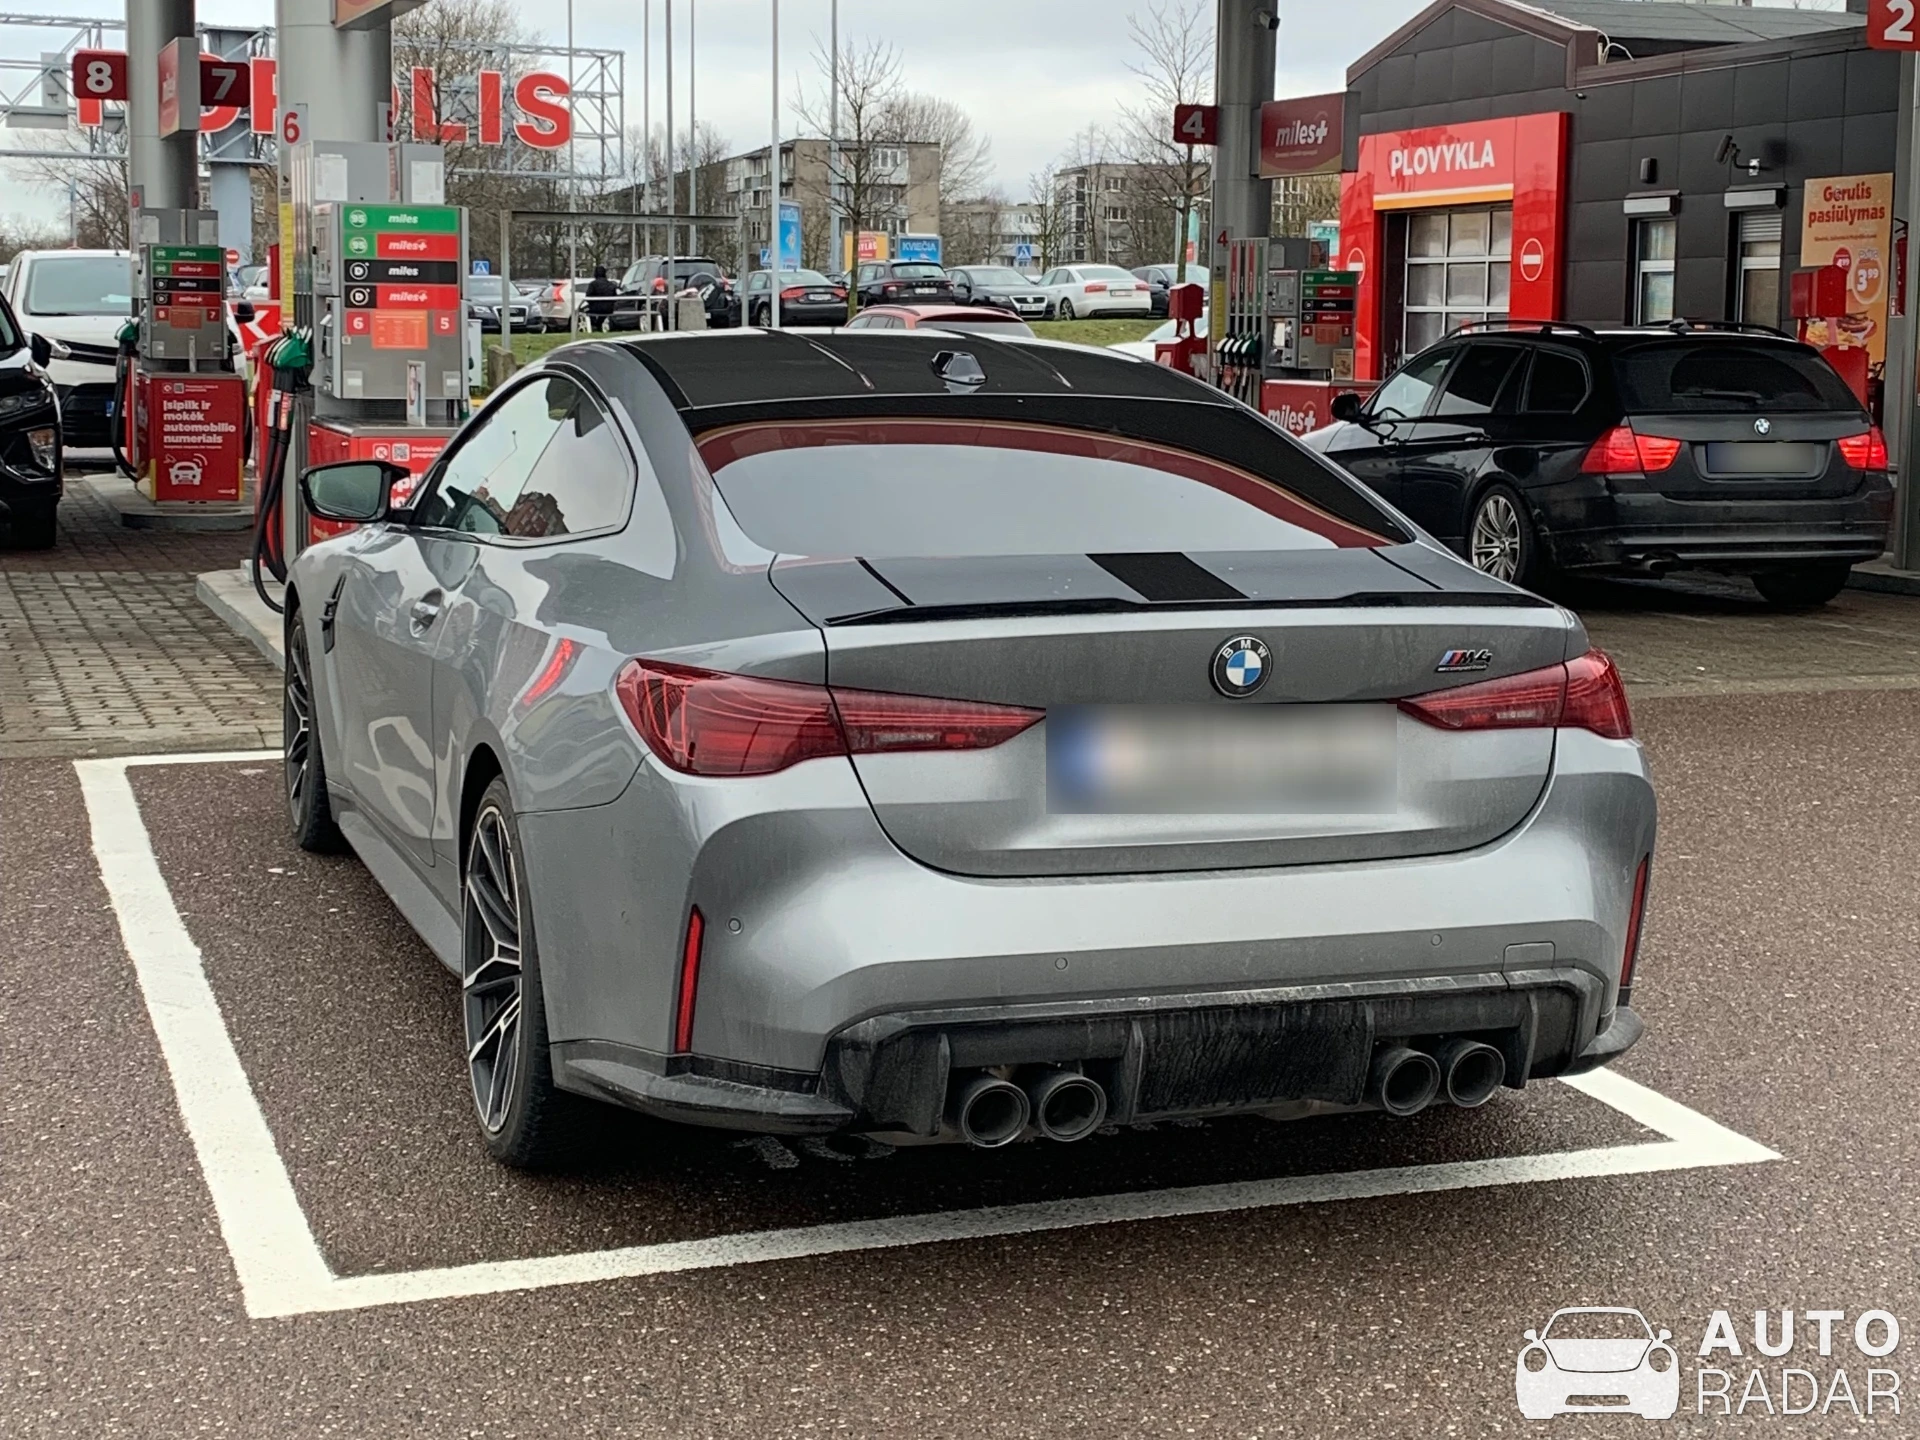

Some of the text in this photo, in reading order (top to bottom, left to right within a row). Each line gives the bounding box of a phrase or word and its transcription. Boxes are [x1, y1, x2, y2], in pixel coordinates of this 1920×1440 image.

[1884, 0, 1915, 42] 2
[86, 60, 114, 94] 8
[211, 68, 237, 100] 7
[283, 111, 301, 144] 6
[1182, 110, 1206, 139] 4
[1275, 119, 1329, 147] miles+
[1390, 139, 1496, 178] PLOVYKLA
[1823, 181, 1872, 202] Gerulis
[388, 214, 418, 224] miles
[1808, 204, 1886, 229] pasiūlymas
[902, 240, 938, 252] KVIEČIA
[1217, 230, 1228, 247] 4
[388, 266, 419, 277] miles
[209, 311, 217, 320] 7
[352, 317, 365, 330] 6
[440, 317, 451, 330] 5
[201, 400, 212, 411] ir
[163, 411, 205, 421] mokėk
[163, 423, 237, 433] automobilio
[163, 434, 223, 444] numeriais
[1221, 639, 1268, 659] BMW
